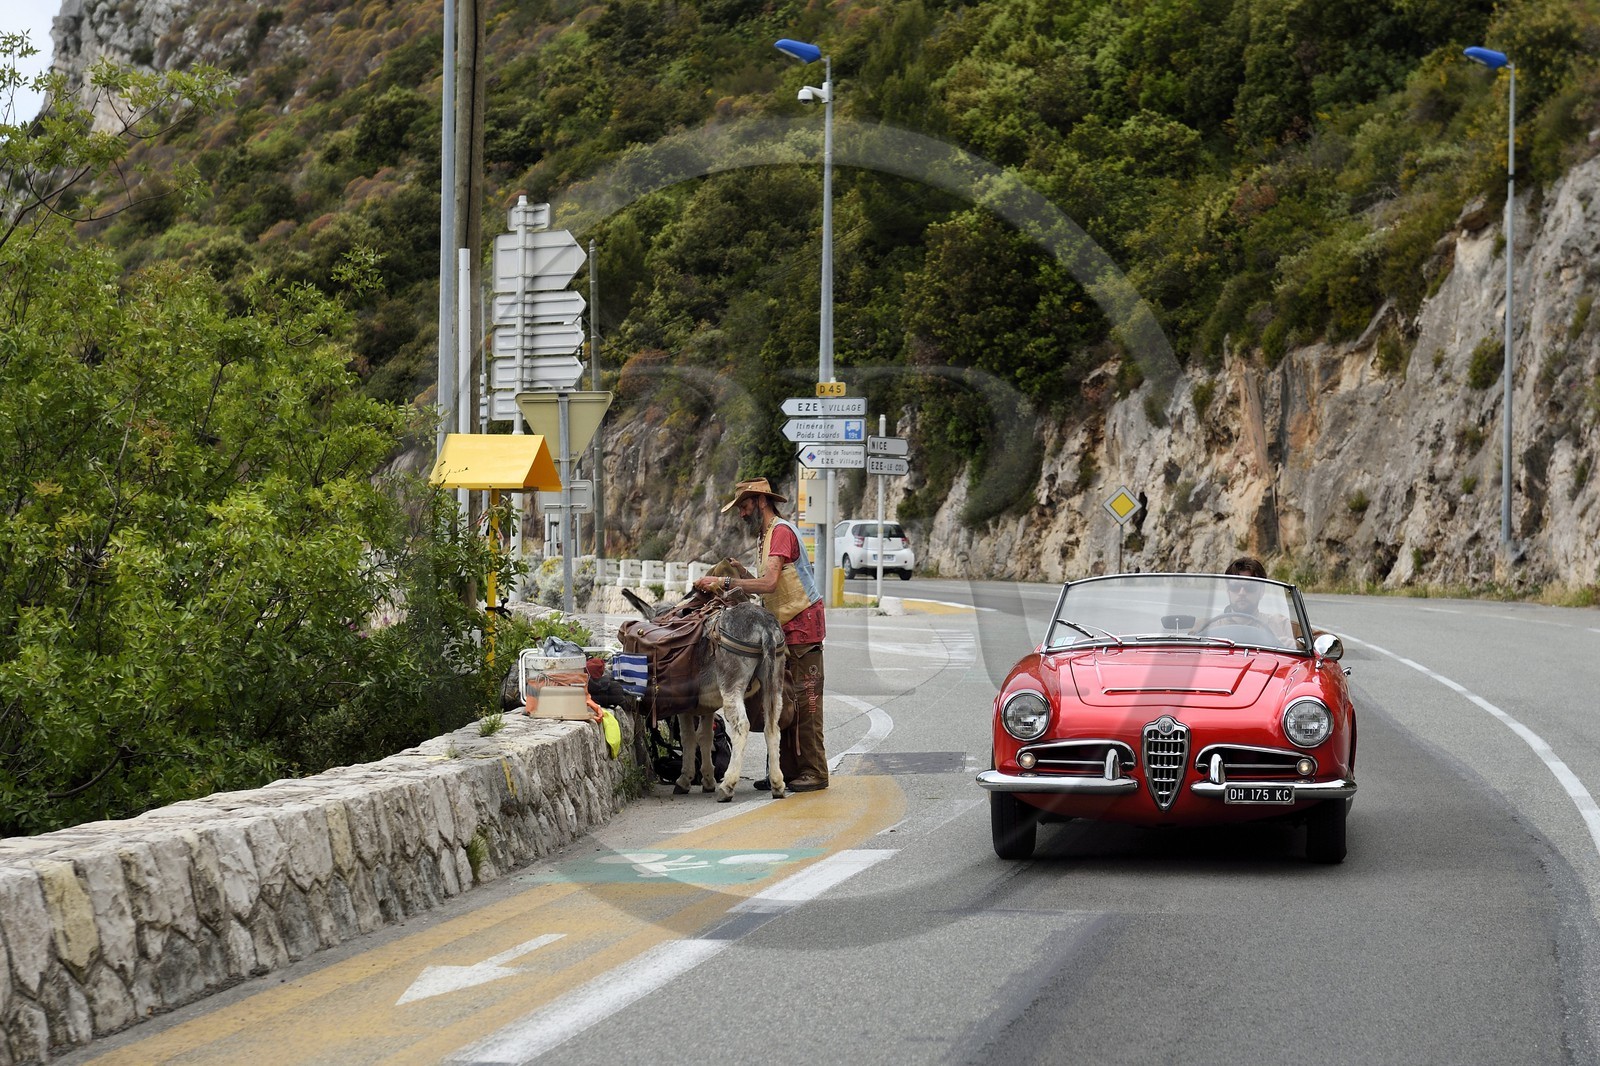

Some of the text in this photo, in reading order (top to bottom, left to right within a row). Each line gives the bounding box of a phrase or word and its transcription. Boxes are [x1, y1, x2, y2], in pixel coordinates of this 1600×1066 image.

[828, 385, 842, 394] 45
[797, 402, 819, 412] EZE
[828, 403, 862, 412] VILLAGE
[796, 422, 835, 430] Itinéraire
[796, 431, 840, 439] Poids Lourds
[871, 440, 888, 451] NICE
[821, 457, 835, 465] EZE
[839, 457, 862, 465] Village
[1230, 788, 1290, 801] DH 175 KC
